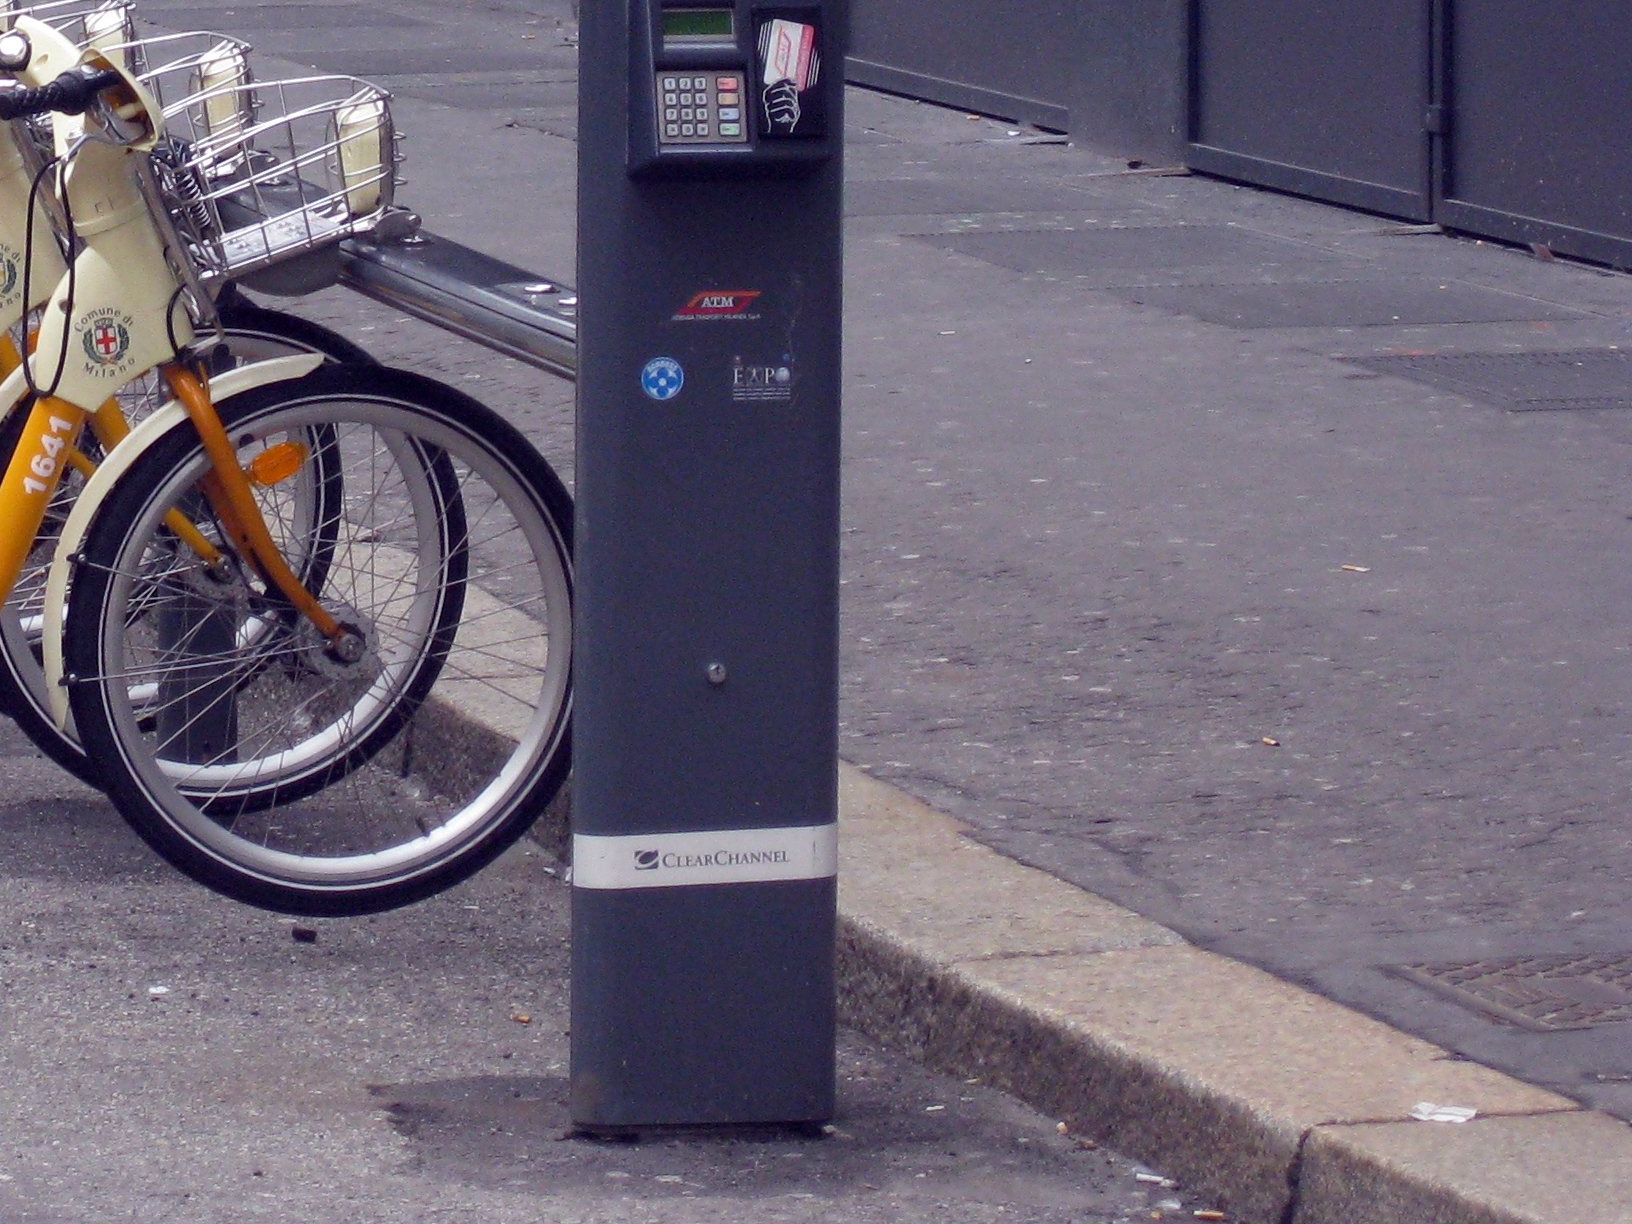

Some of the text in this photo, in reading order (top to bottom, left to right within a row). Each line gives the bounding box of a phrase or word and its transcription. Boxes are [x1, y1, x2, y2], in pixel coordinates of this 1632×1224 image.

[11, 252, 21, 263] di
[701, 296, 734, 308] ATM
[74, 307, 134, 332] Comune di
[84, 357, 135, 377] Milano
[23, 416, 72, 494] 1641
